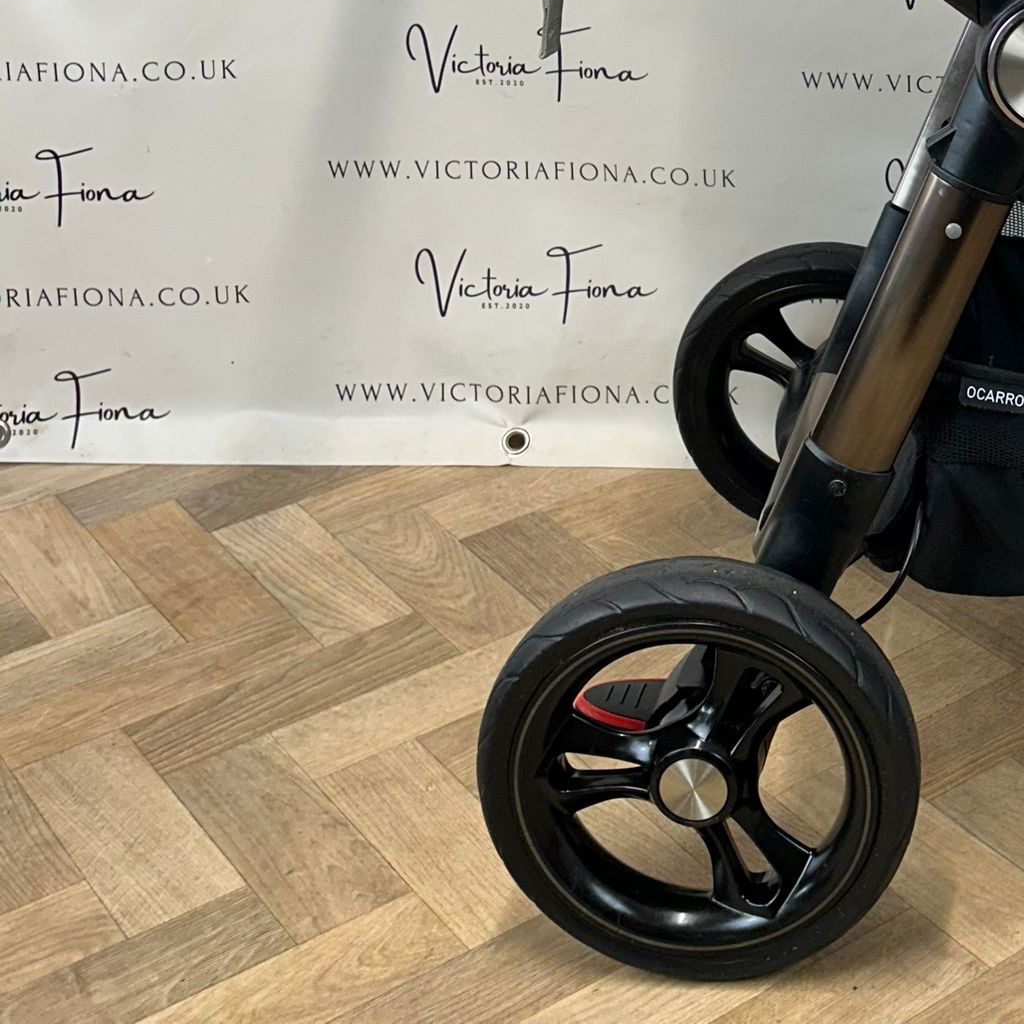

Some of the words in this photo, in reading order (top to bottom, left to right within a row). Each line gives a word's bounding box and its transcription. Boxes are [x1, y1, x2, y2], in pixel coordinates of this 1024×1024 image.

[405, 22, 543, 95] Victoria
[534, 20, 649, 103] Fiona
[475, 78, 525, 88] EST.2020
[35, 146, 156, 228] Fiona
[327, 159, 736, 188] WWW.VICTORIAFIONA.CO.UK
[414, 247, 551, 318] Victoria
[544, 243, 659, 326] Fiona
[481, 297, 531, 310] EST.2020
[53, 367, 172, 451] Fiona
